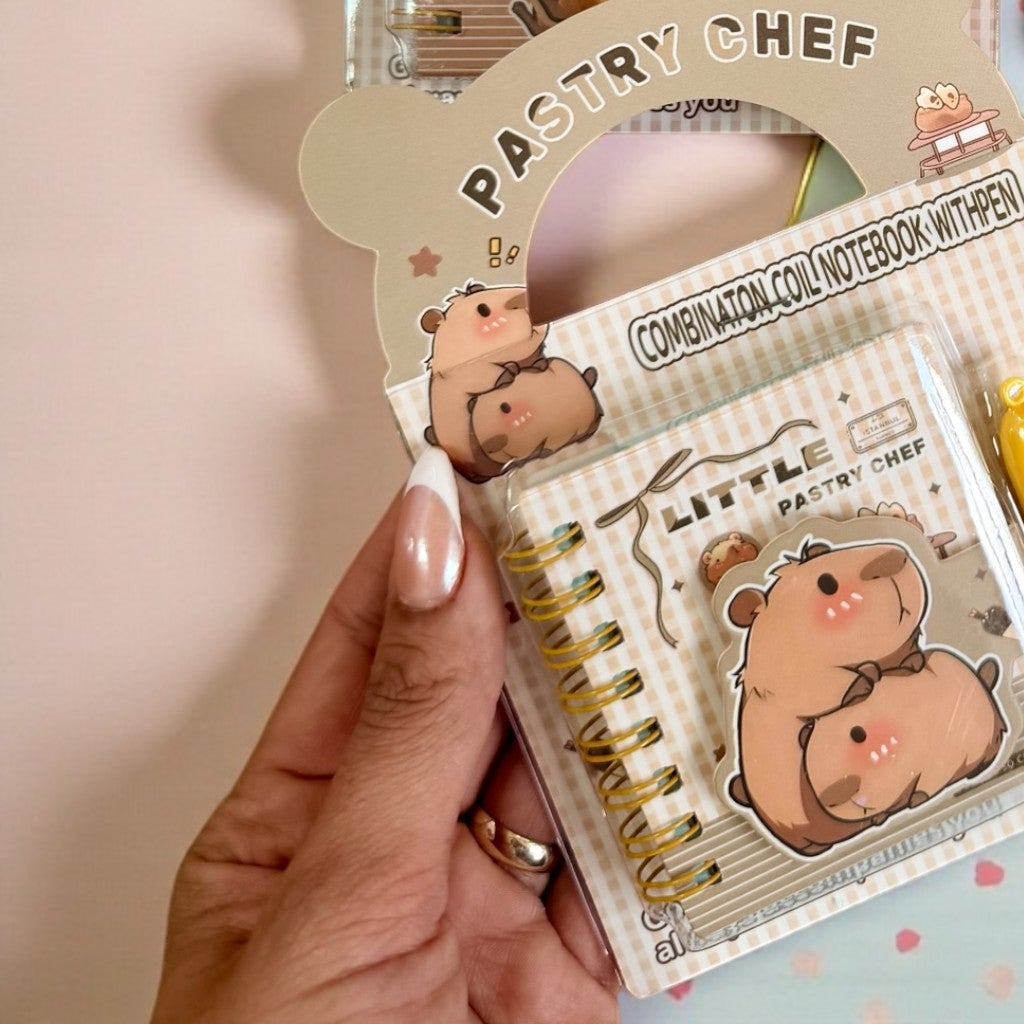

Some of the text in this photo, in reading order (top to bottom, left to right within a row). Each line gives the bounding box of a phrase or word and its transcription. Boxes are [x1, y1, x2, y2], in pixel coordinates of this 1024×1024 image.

[459, 10, 877, 217] PASTRY CHEF
[637, 178, 1021, 362] COMBINATON COIL NOTEBOOK WITHPEN
[660, 438, 833, 533] LITTLE
[778, 438, 926, 516] PASTRY CHEF
